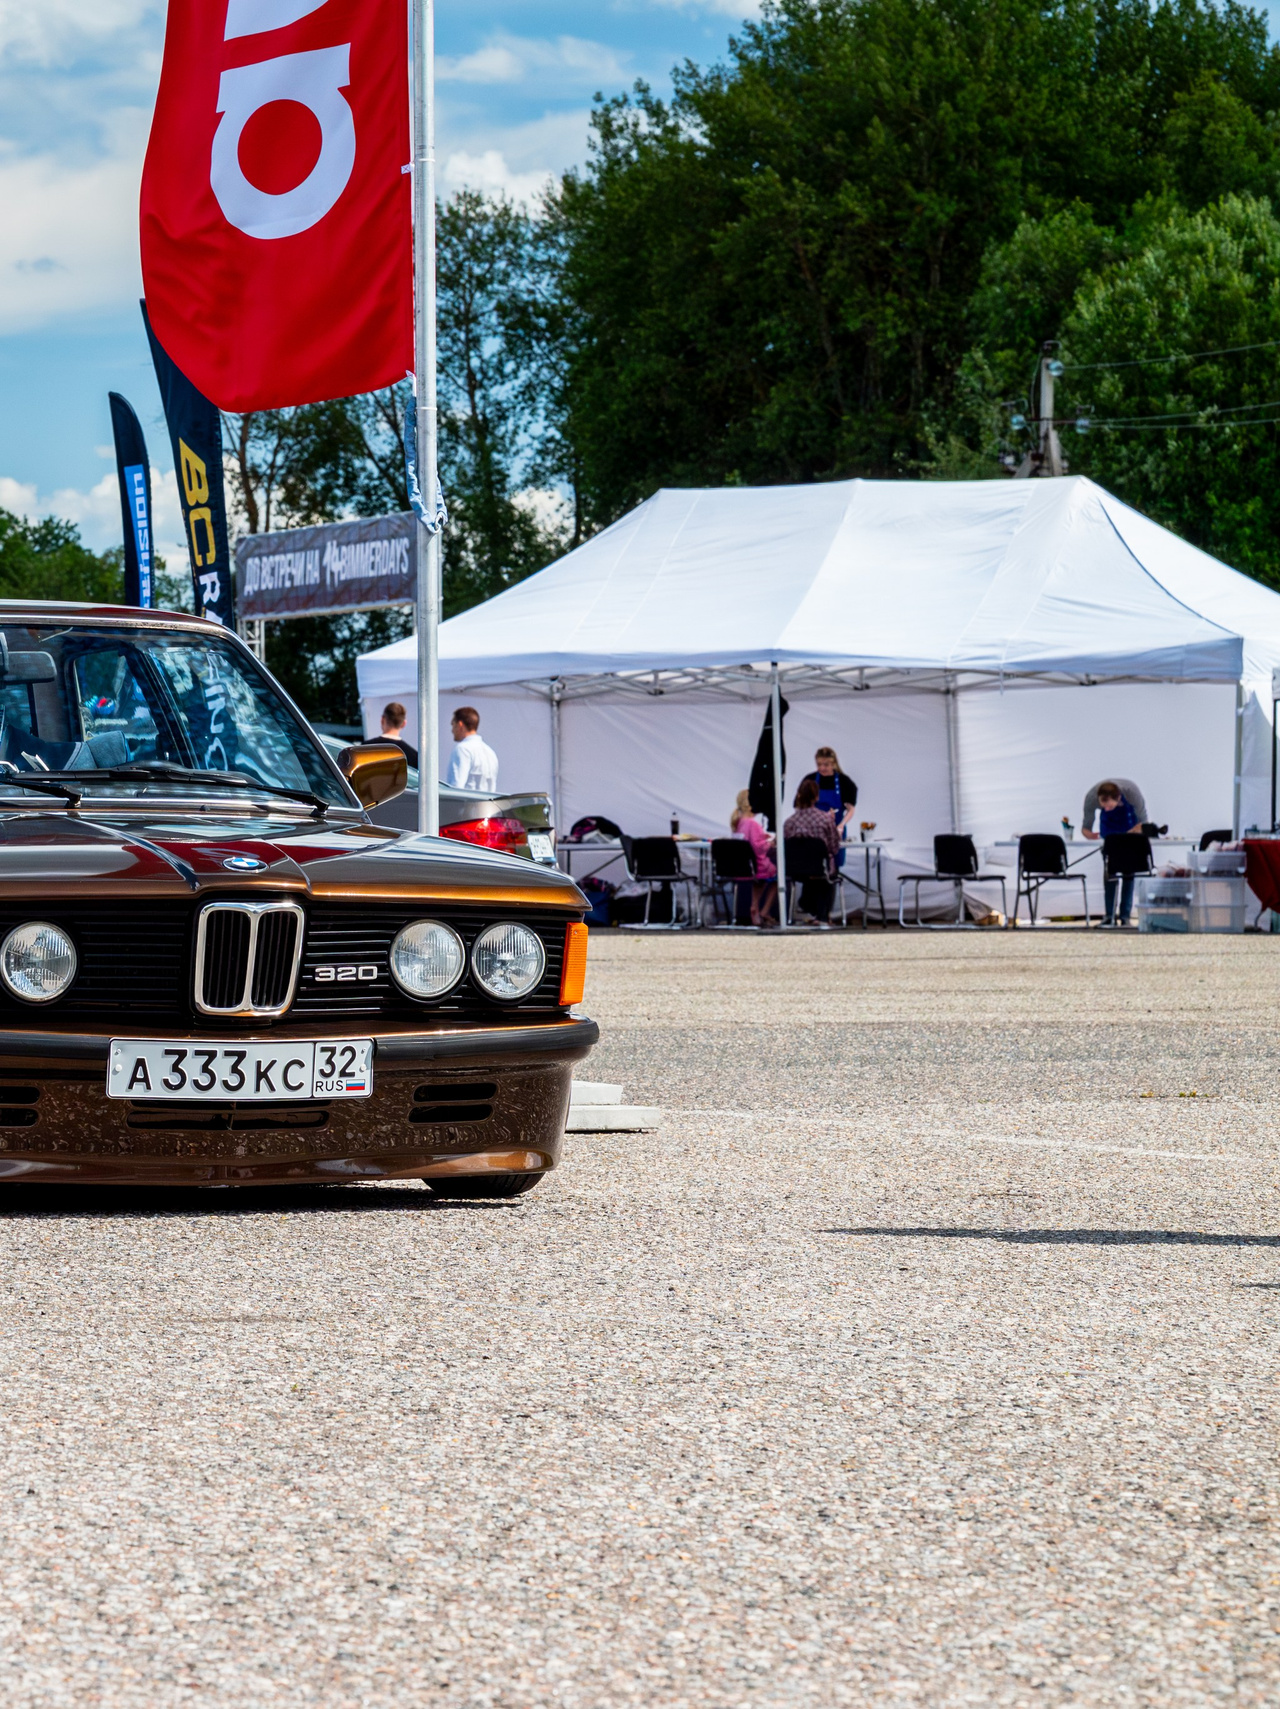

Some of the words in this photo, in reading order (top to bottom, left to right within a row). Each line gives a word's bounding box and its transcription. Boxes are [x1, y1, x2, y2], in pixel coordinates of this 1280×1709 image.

[261, 551, 305, 590] ВСТРЕЧИ
[306, 549, 320, 585] НА
[315, 965, 378, 982] 320
[319, 1045, 357, 1078] 32
[315, 1080, 344, 1092] RUS
